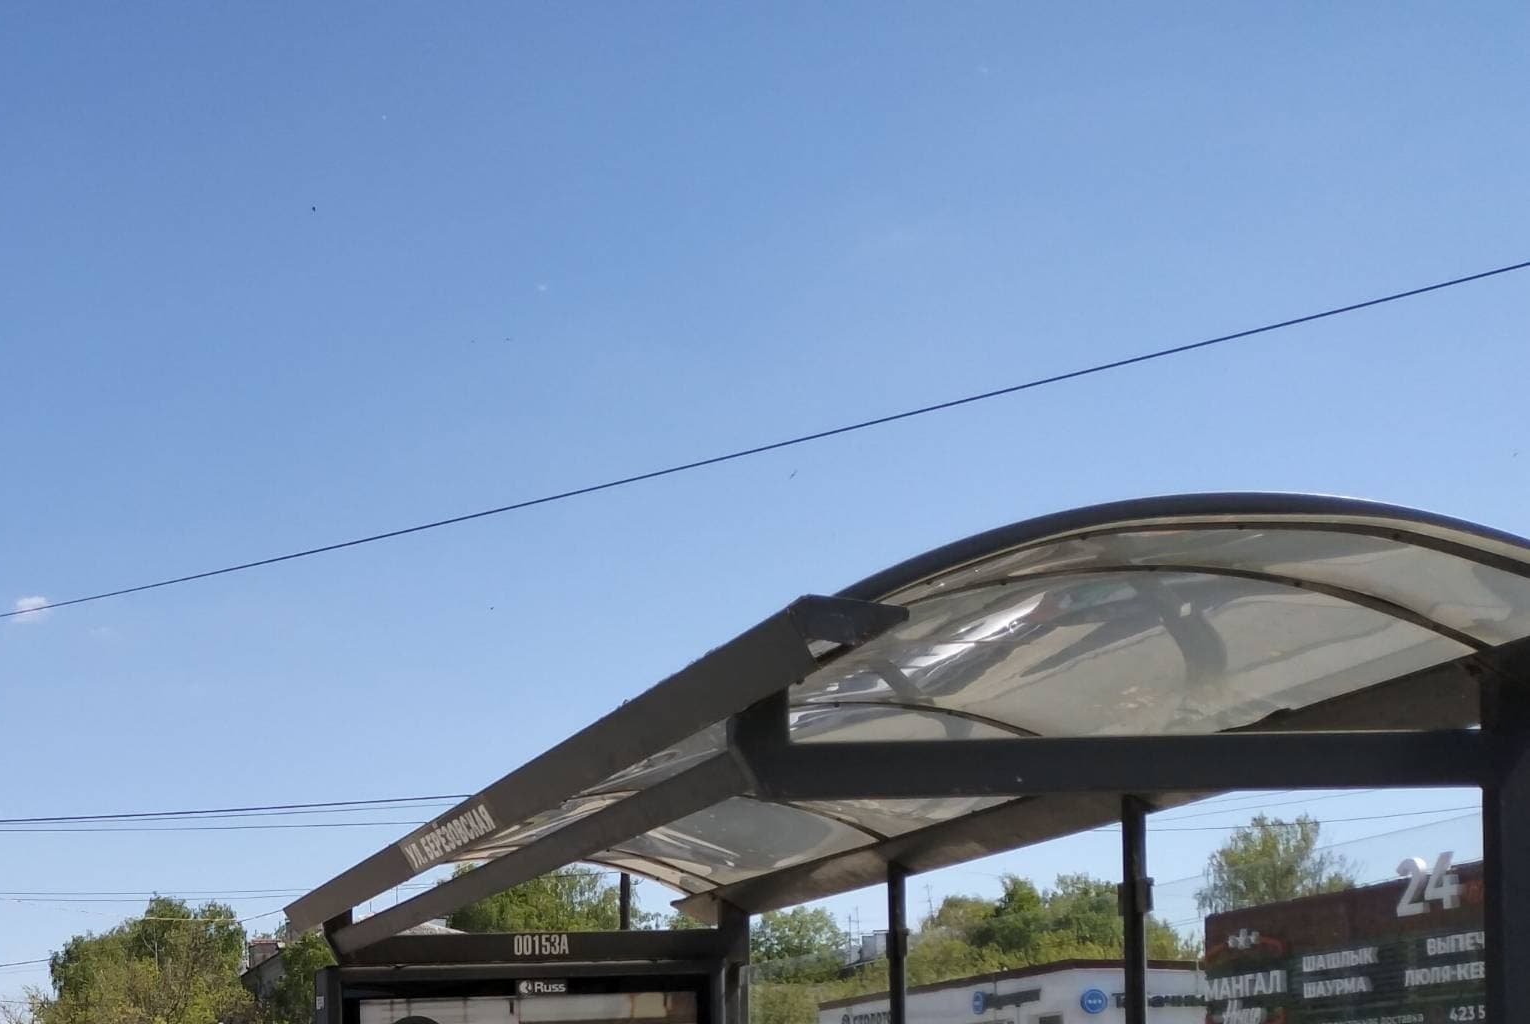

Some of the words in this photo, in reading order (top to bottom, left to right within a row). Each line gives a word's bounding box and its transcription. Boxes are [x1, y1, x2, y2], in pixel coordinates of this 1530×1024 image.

[405, 841, 429, 869] УЛ.
[421, 804, 496, 861] БЕРЁЗОВСКАЯ
[1396, 851, 1463, 917] 24
[1302, 947, 1378, 972] ШАШЛЫК
[534, 981, 566, 993] Russ
[1204, 969, 1287, 1001] МАНГАЛ
[1303, 976, 1371, 999] ШАУРМА
[1449, 1005, 1475, 1022] 423
